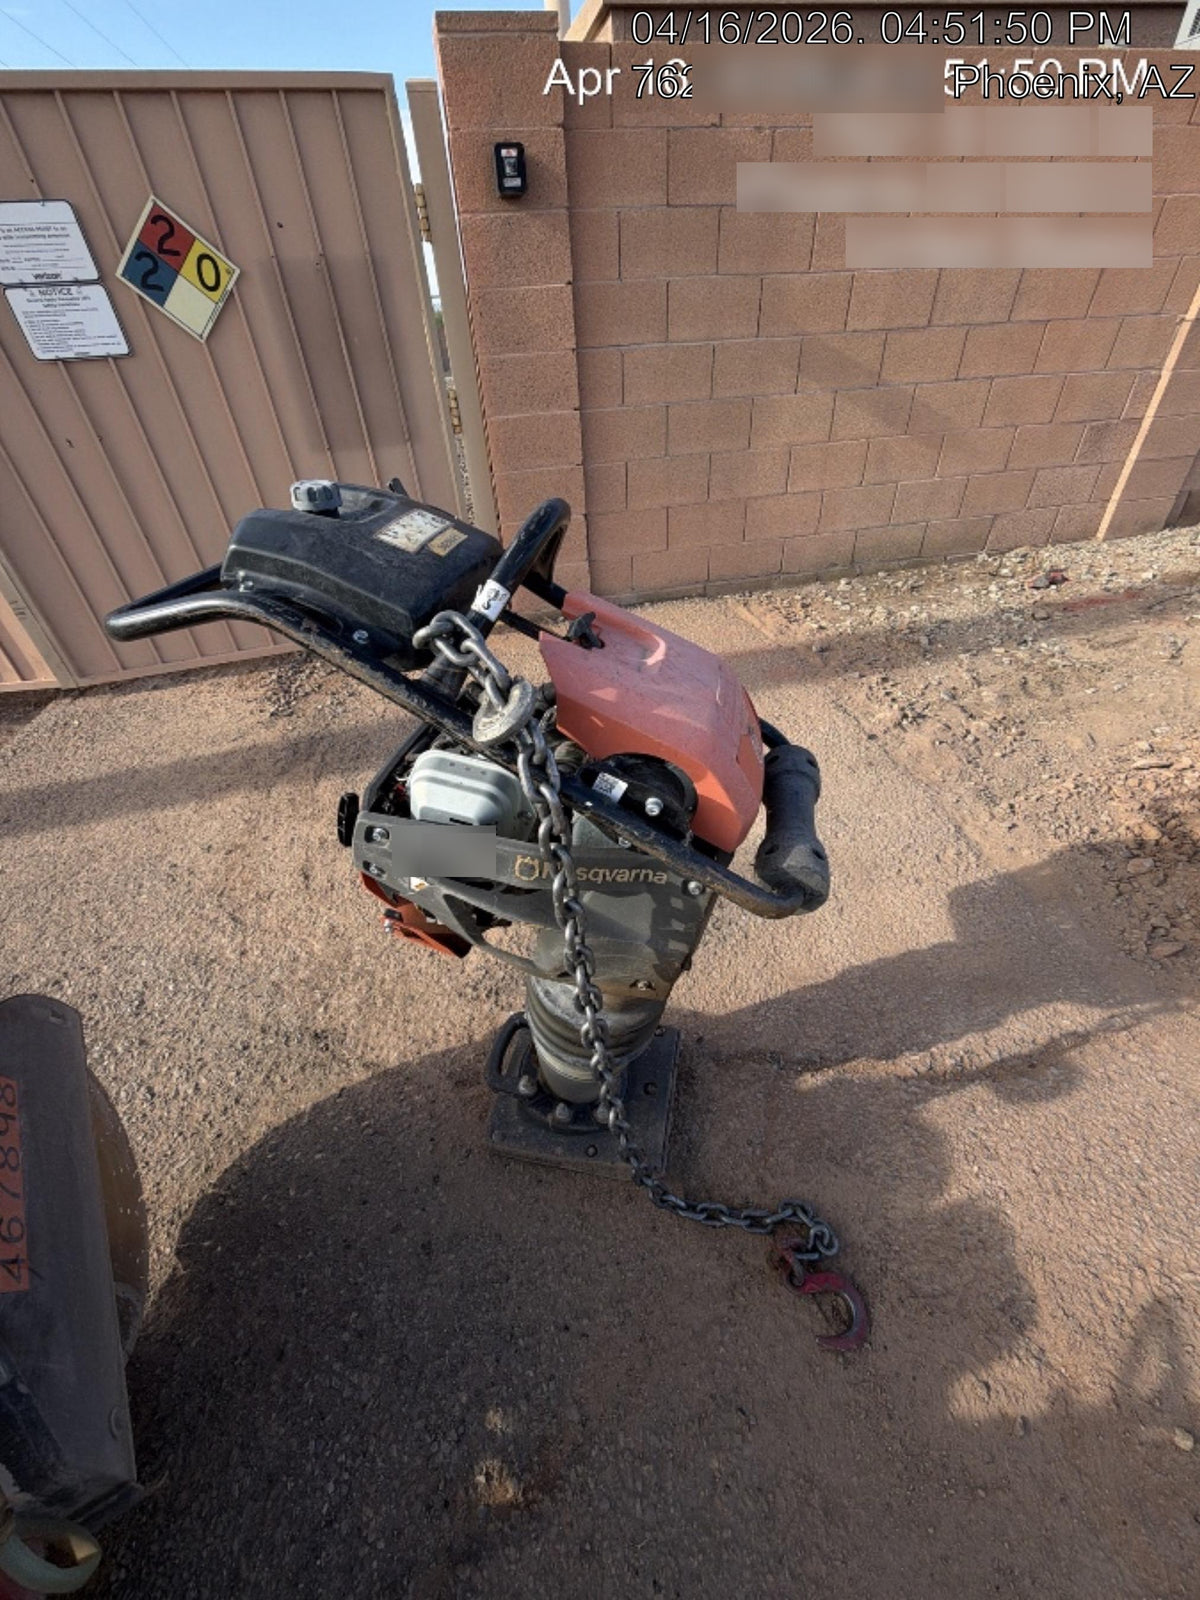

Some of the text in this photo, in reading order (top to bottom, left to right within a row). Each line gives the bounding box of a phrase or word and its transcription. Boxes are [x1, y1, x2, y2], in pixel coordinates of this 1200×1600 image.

[151, 214, 181, 257] 2
[134, 251, 165, 292] 2
[196, 253, 222, 292] 0
